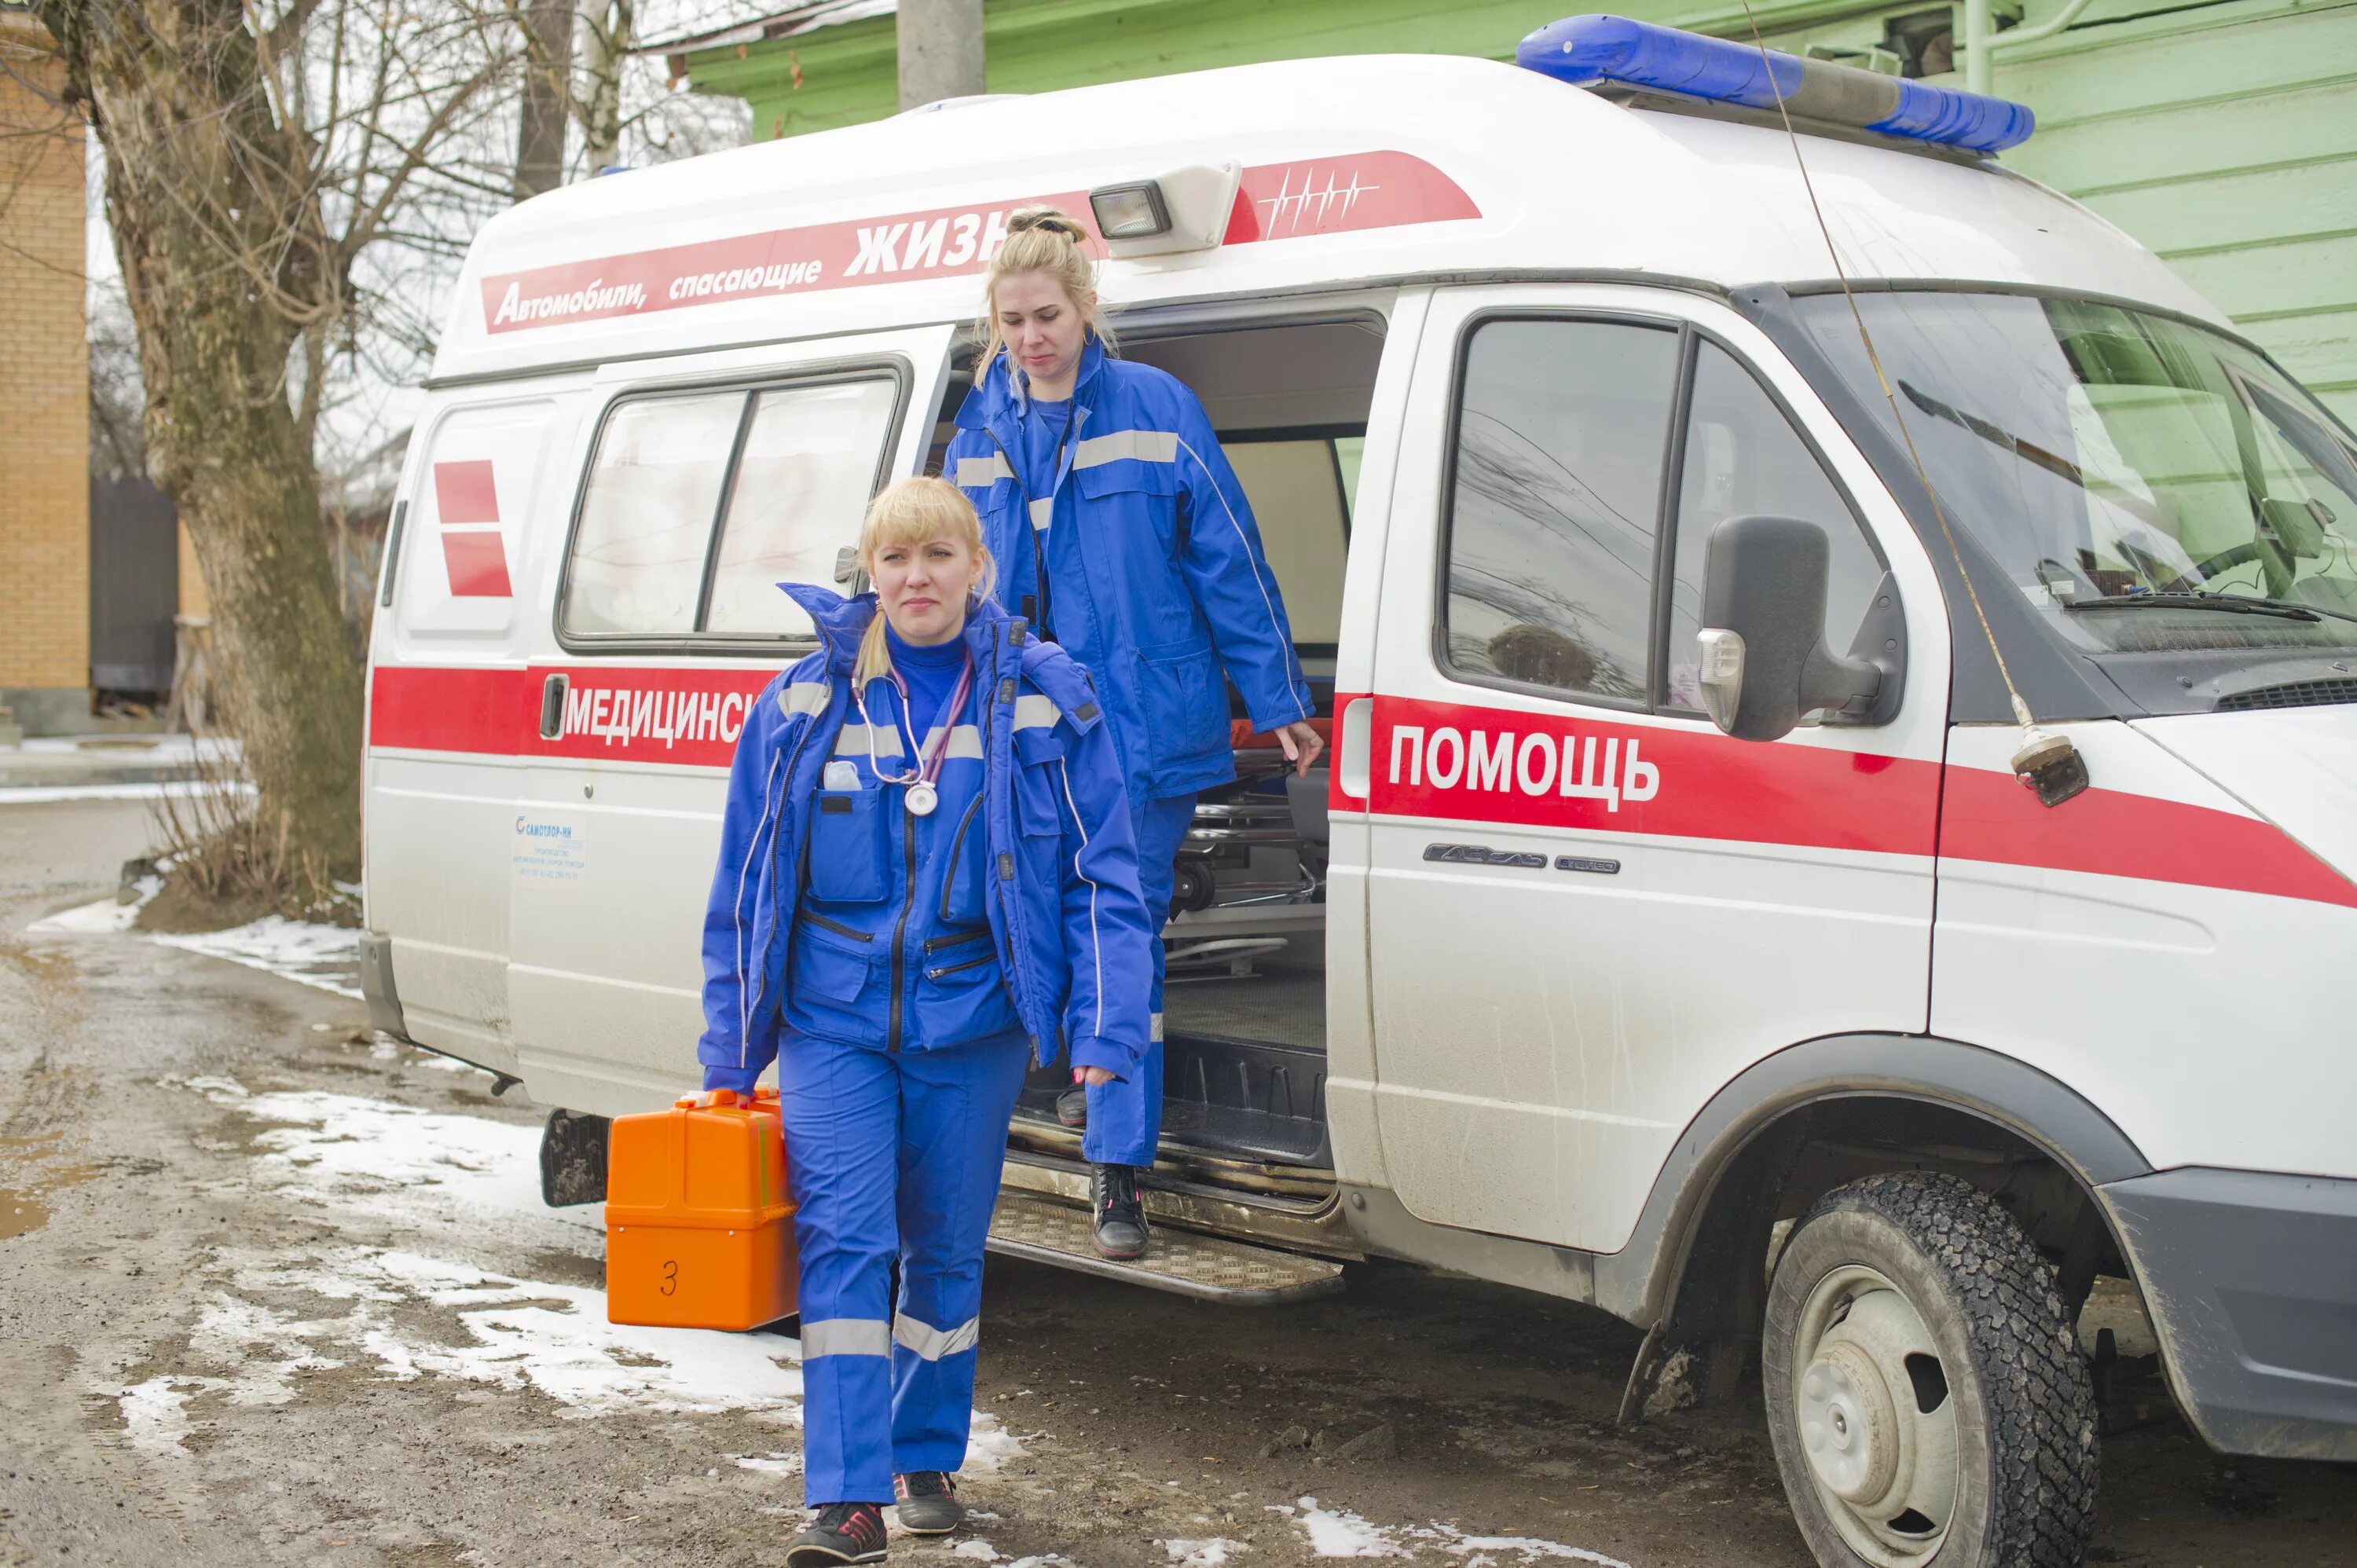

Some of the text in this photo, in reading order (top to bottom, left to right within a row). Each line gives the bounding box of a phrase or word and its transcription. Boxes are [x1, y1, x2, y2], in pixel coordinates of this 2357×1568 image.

[493, 280, 647, 326] Автомобили,
[669, 258, 823, 301] спасающие
[1388, 724, 1660, 813] ПОМОЩЬ
[526, 823, 572, 839] САМОТЛОР-НН
[660, 1260, 678, 1296] 3
